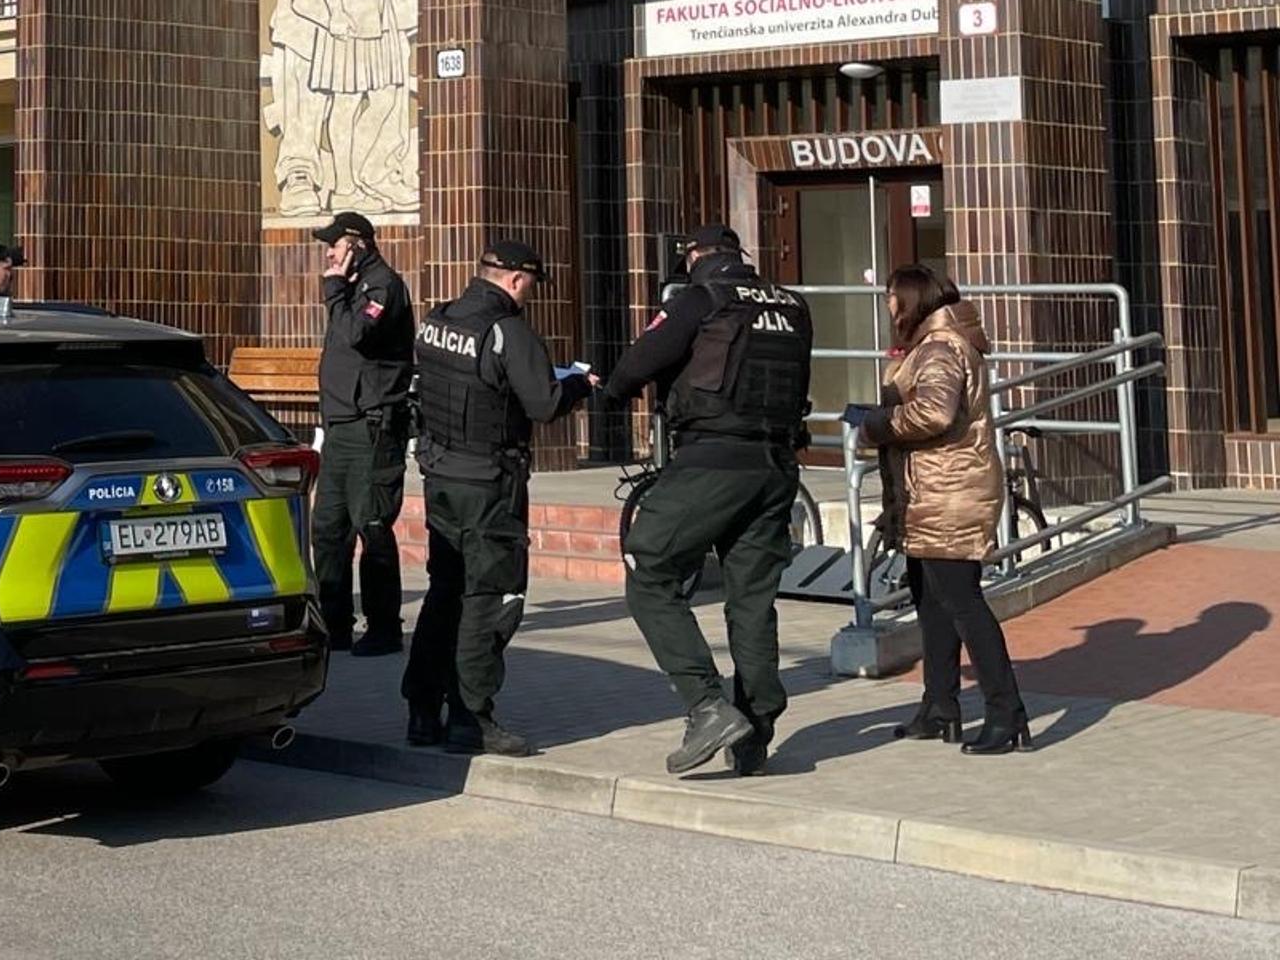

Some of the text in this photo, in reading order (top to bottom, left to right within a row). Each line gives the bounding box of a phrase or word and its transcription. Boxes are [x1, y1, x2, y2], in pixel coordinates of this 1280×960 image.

[656, 2, 730, 24] FAKULTA
[768, 17, 834, 34] univerzita
[837, 10, 908, 28] Alexandra
[972, 9, 983, 28] 3
[791, 134, 933, 167] BUDOVA
[415, 321, 477, 359] POLÍCIA
[88, 484, 136, 500] POLÍCIA
[118, 524, 144, 548] EL
[153, 519, 221, 546] 279AB
